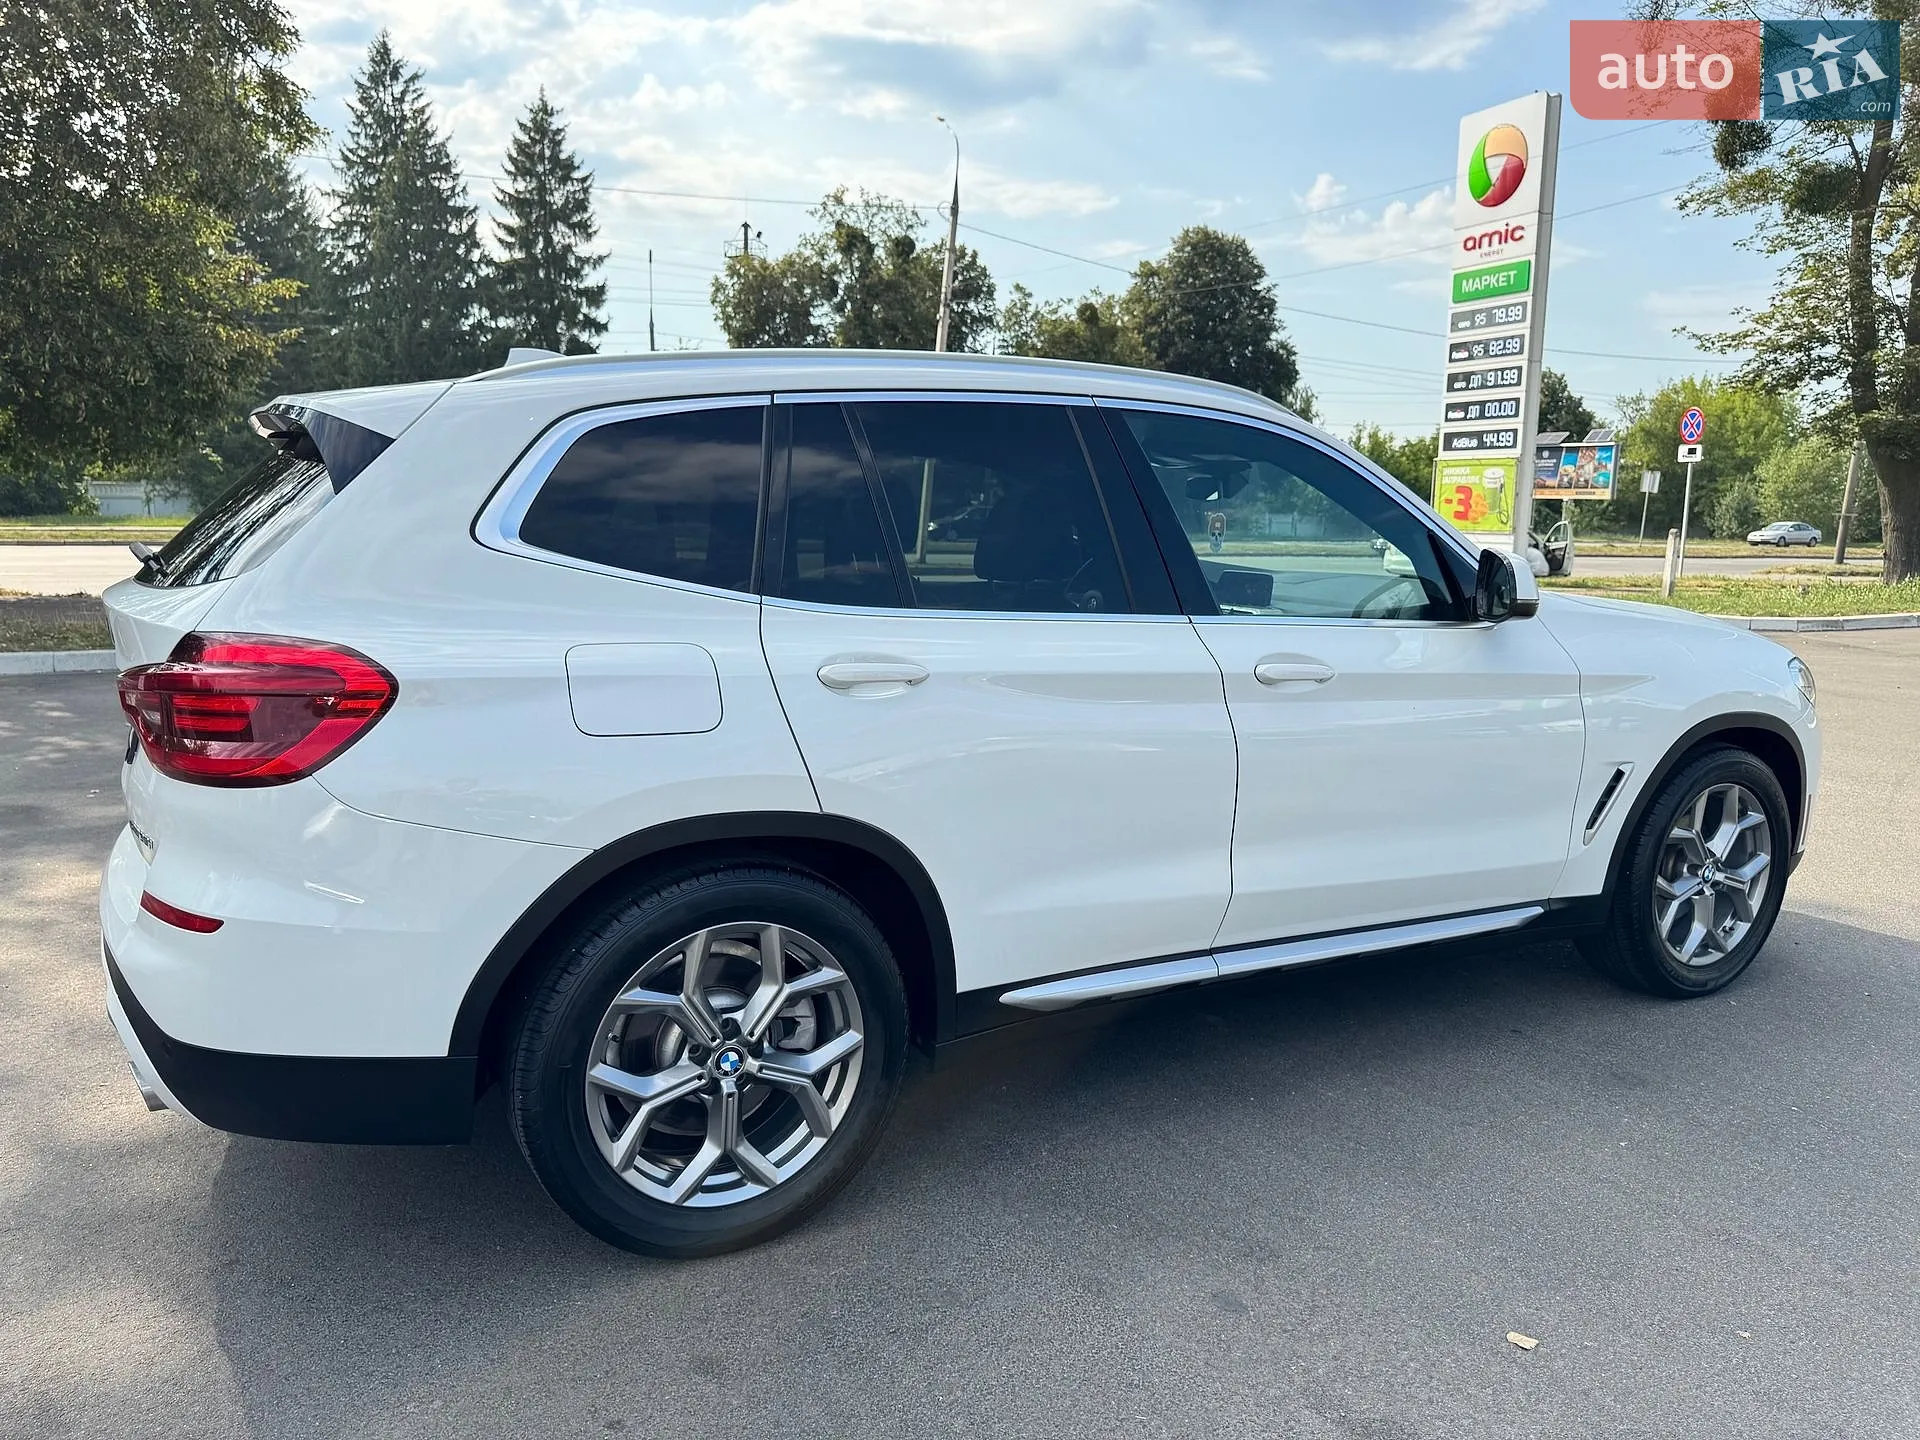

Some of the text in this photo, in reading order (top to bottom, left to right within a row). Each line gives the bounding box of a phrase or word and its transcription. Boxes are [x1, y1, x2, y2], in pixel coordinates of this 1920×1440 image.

[1463, 222, 1525, 252] amic
[1461, 270, 1518, 294] МАРКЕТ
[1474, 312, 1487, 326] 95
[1492, 305, 1523, 323] 79.99
[1472, 343, 1485, 357] 95
[1489, 337, 1521, 355] 82.99
[1468, 374, 1482, 389] ДП
[1486, 368, 1519, 386] 91.99
[1466, 404, 1480, 419] ДП
[1484, 400, 1516, 417] 00.00
[1451, 432, 1514, 448] AdBlue 44.99
